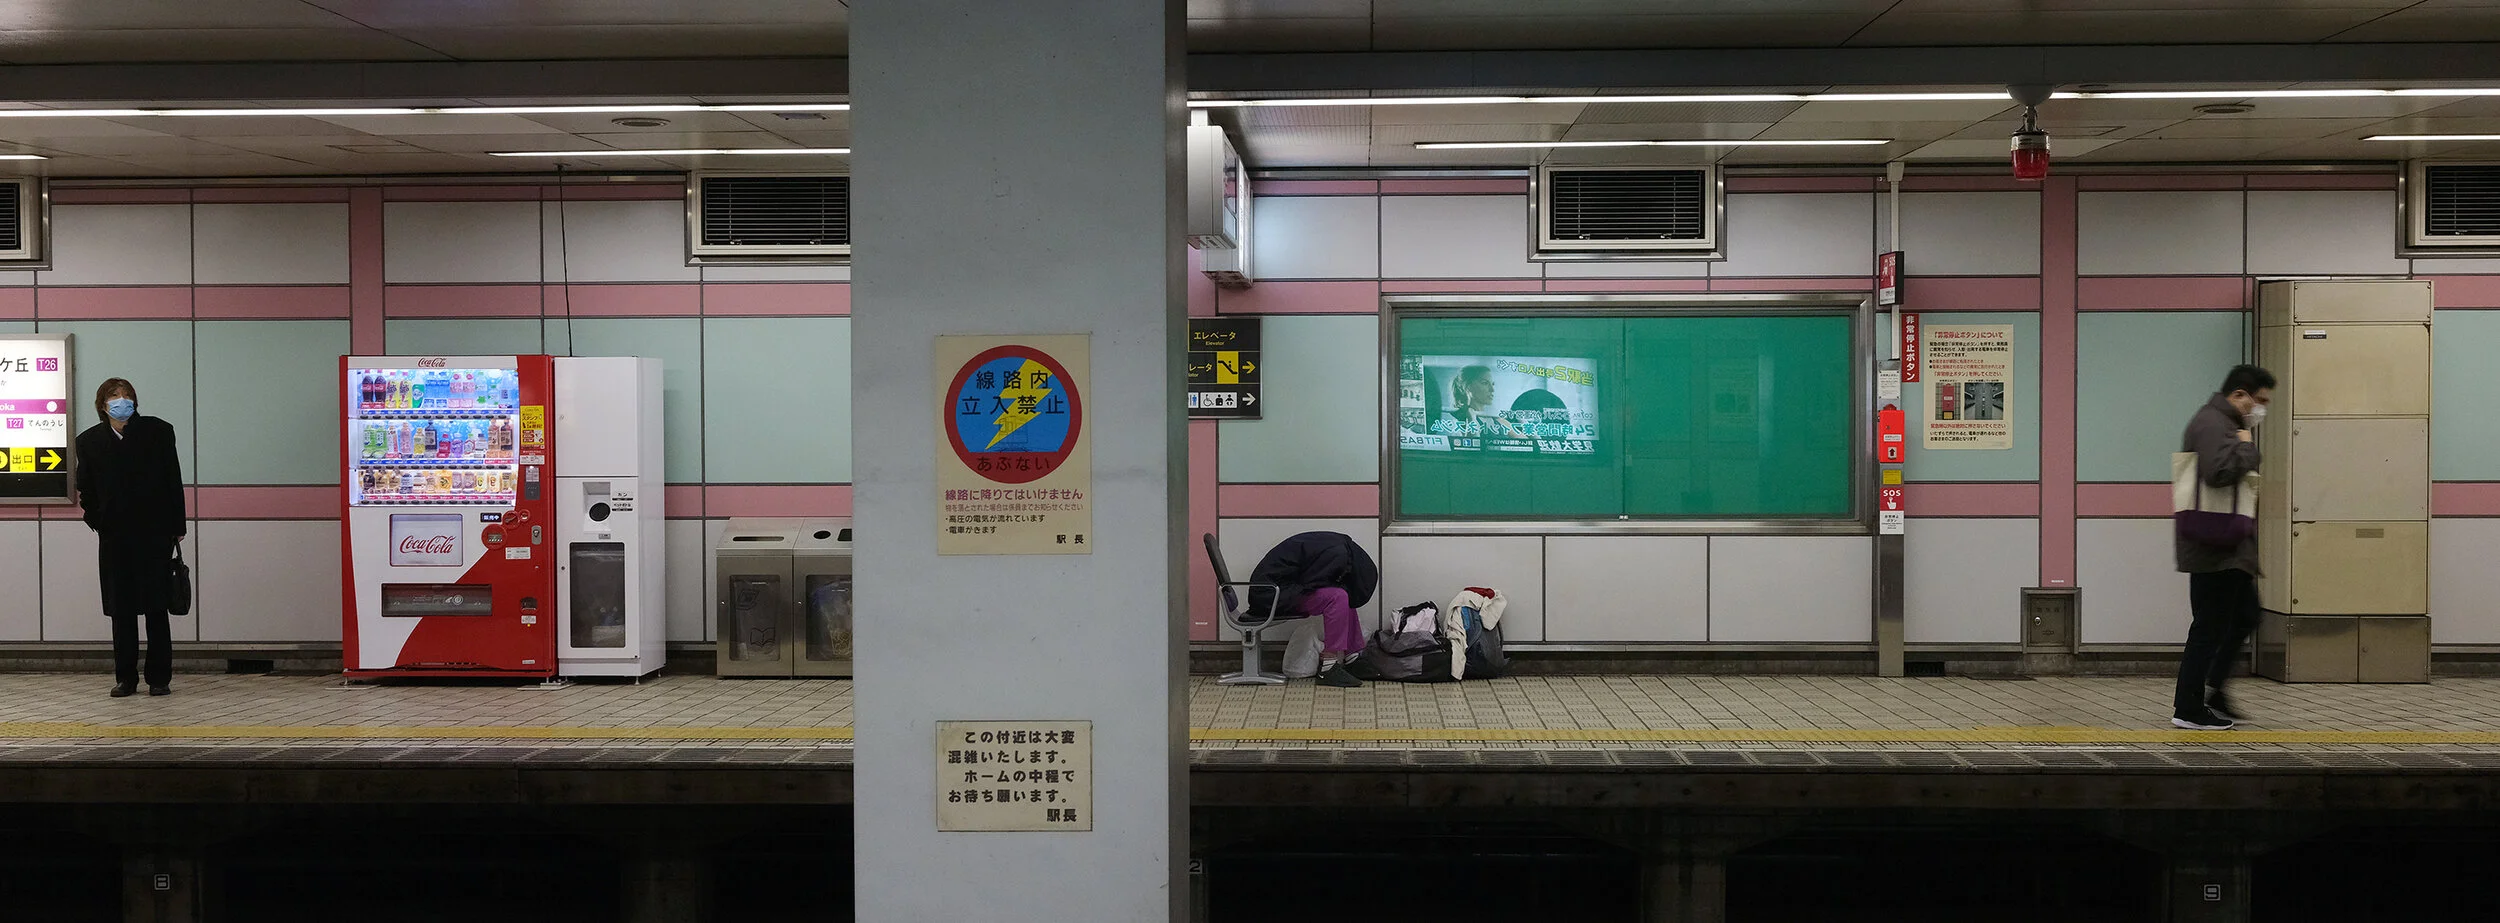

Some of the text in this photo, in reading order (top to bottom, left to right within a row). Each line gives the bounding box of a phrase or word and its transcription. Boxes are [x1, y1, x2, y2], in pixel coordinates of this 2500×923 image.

[1194, 331, 1236, 341] エレベータ
[1906, 315, 1915, 381] 非常停止ボタン
[38, 359, 57, 370] T26
[975, 370, 1049, 390] 線路内
[962, 395, 1065, 415] 立入禁止
[9, 419, 22, 428] T27
[28, 419, 64, 427] てんのうじ
[12, 454, 33, 465] 出口
[977, 456, 1050, 472] あぶない
[945, 489, 1083, 501] 線路に降りてはいけません
[1883, 489, 1901, 497] SOS
[1056, 534, 1084, 544] 駅長
[965, 730, 1075, 744] この付近は大変
[948, 750, 1067, 764] 混雑いたします。
[965, 769, 1075, 784] ホームの中程で
[948, 789, 1067, 803] お待ち願います。
[1047, 808, 1077, 822] 駅長
[2205, 885, 2219, 900] 9
